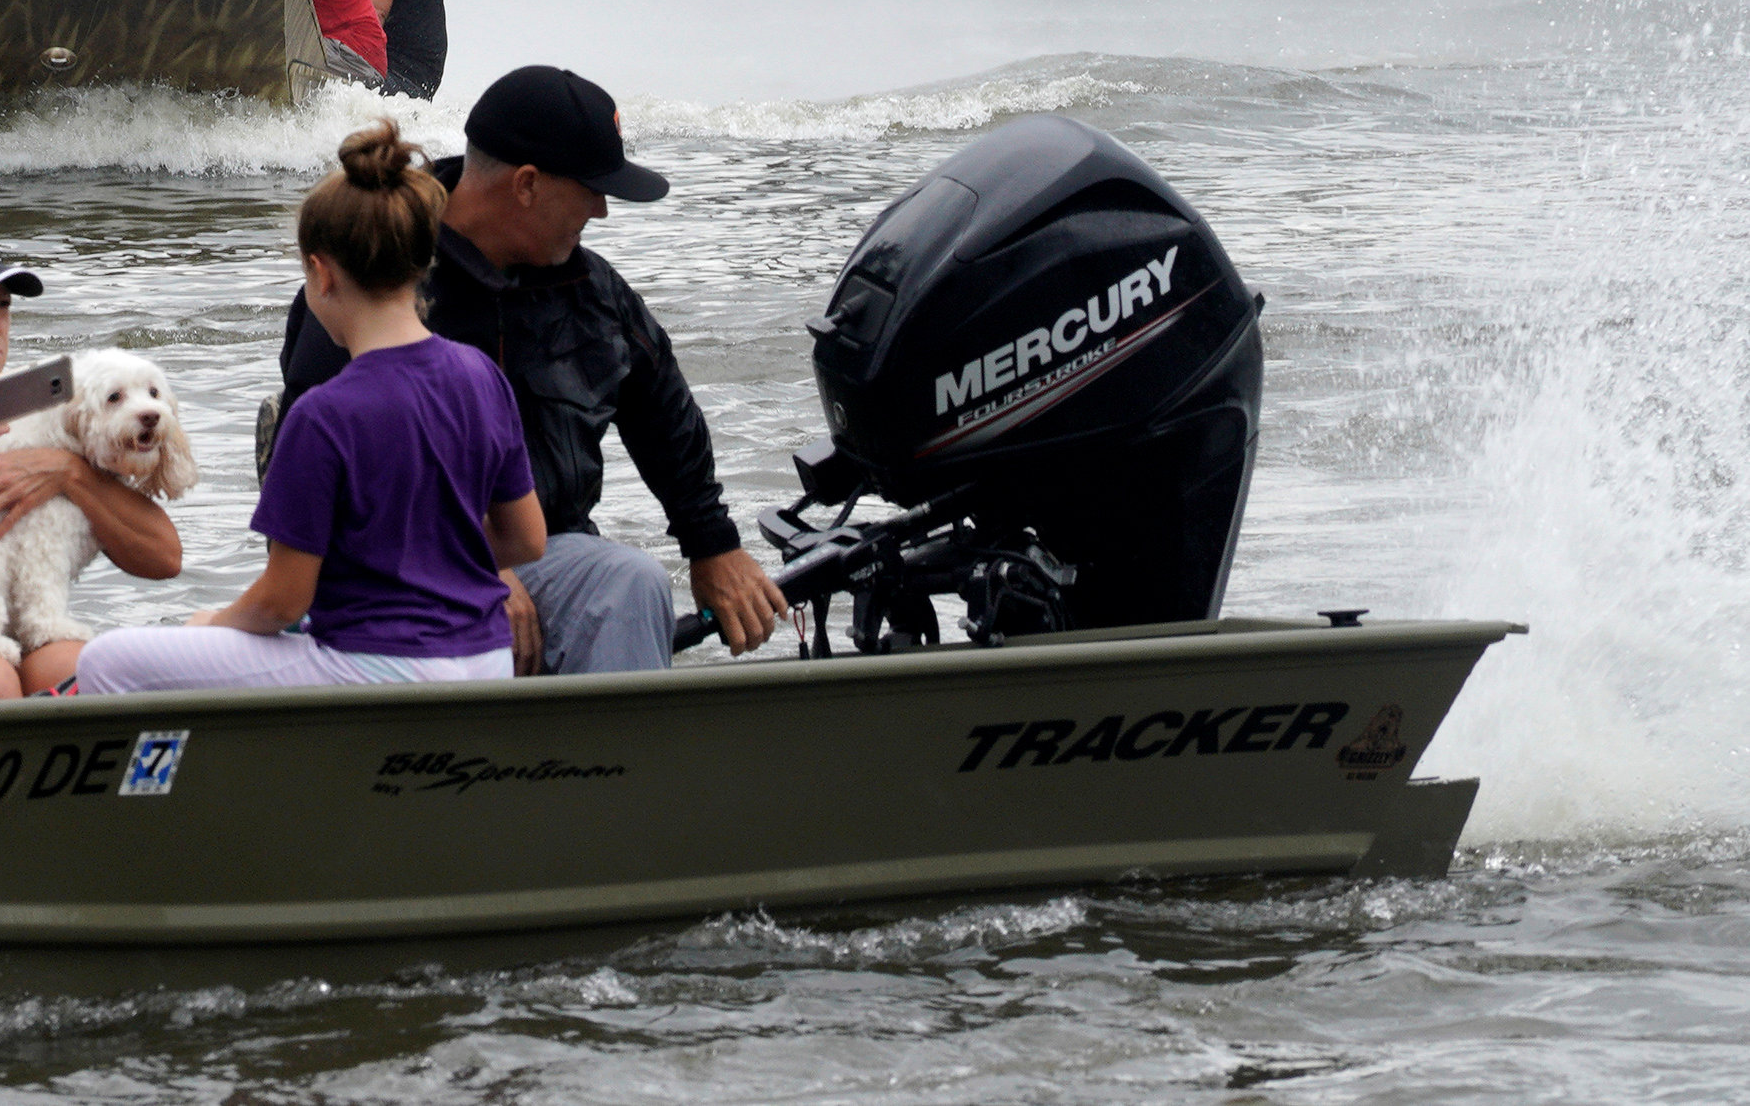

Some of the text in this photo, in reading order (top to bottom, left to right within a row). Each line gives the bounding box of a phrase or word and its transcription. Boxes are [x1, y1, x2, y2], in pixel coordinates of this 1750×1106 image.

[934, 244, 1179, 417] MERCURY
[957, 336, 1117, 428] FOURSTROKE
[28, 739, 128, 801] DE
[957, 700, 1350, 773] TRACKER
